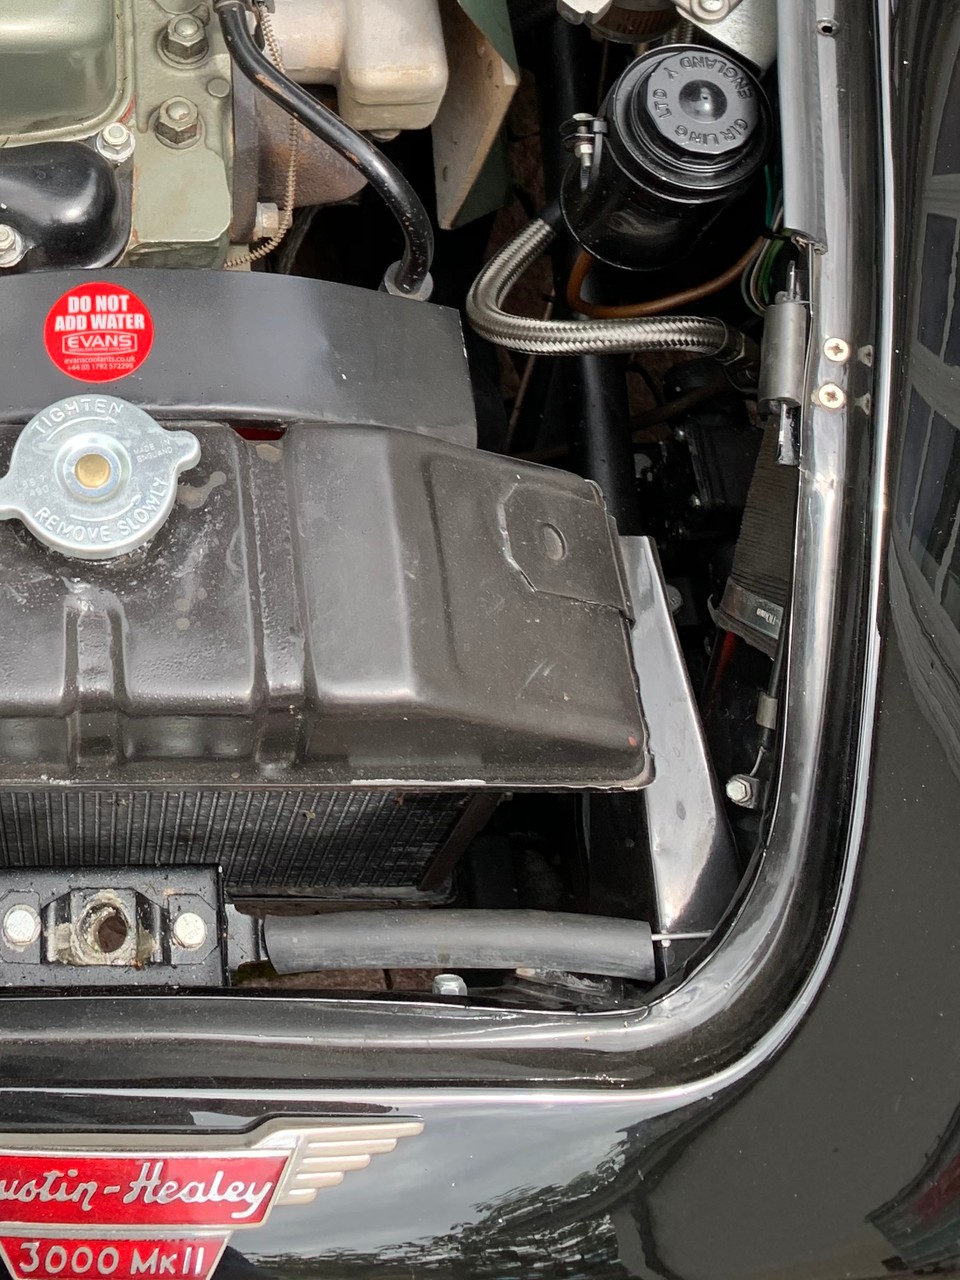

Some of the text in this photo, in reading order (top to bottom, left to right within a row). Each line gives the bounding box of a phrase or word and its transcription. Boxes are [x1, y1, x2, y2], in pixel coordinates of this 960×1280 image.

[680, 56, 752, 100] ENGLAND
[653, 88, 748, 145] GIRLING LTD
[68, 294, 130, 313] DO NOT
[54, 313, 145, 332] ADD WATER
[67, 334, 132, 348] EVANS
[64, 355, 136, 364] evanscoolants.co.uk
[31, 397, 124, 435] TIGHTEN
[33, 476, 169, 542] REMOVE SLOWLY
[18, 1241, 119, 1275] 3000
